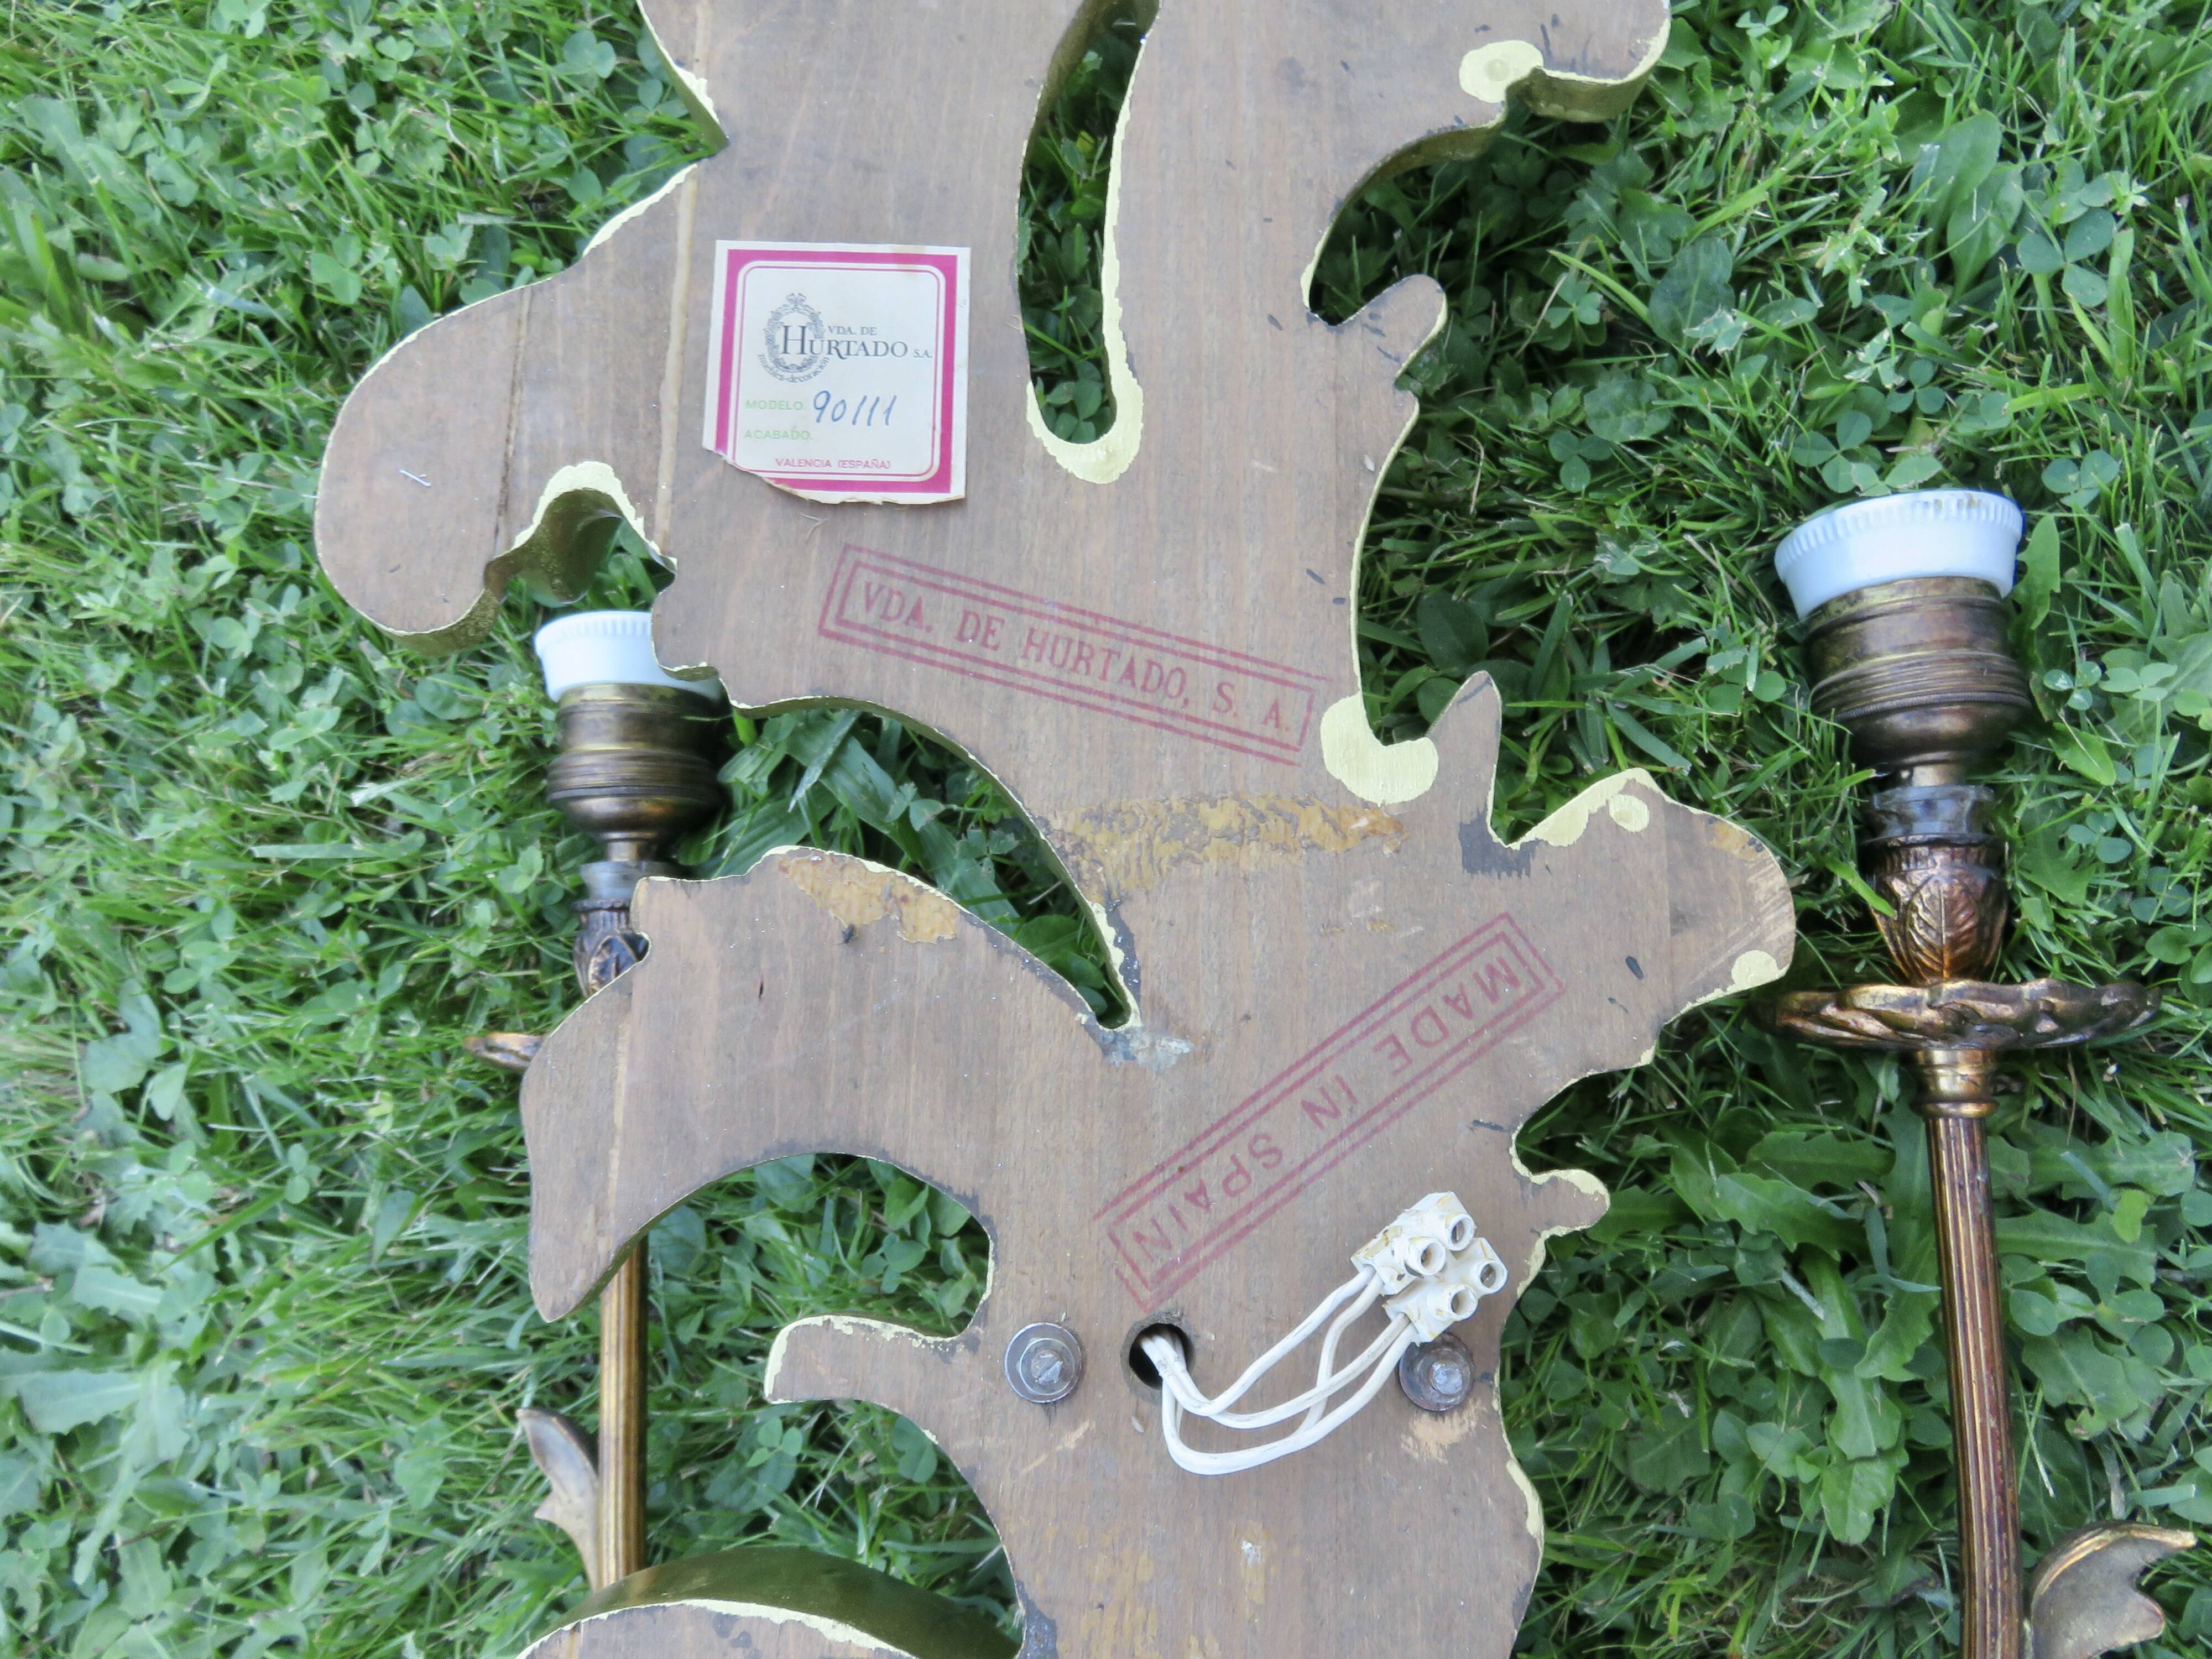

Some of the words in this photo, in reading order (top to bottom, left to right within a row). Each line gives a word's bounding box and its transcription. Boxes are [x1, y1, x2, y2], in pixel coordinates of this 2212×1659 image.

[780, 325, 908, 360] HURTADO
[828, 325, 856, 336] VDA.
[860, 326, 878, 336] DE
[813, 389, 898, 427] 90111
[775, 457, 832, 468] VALENCIA
[838, 458, 891, 470] (ESPAÑA)
[861, 580, 933, 634] VDA.
[956, 609, 1005, 649] DE
[1021, 627, 1190, 707] HURTADO,
[1212, 681, 1238, 718] S.
[1261, 697, 1291, 733] A.
[1371, 955, 1521, 1077] MADE
[1300, 1073, 1359, 1131] IN
[1131, 1131, 1284, 1263] SPAIN
